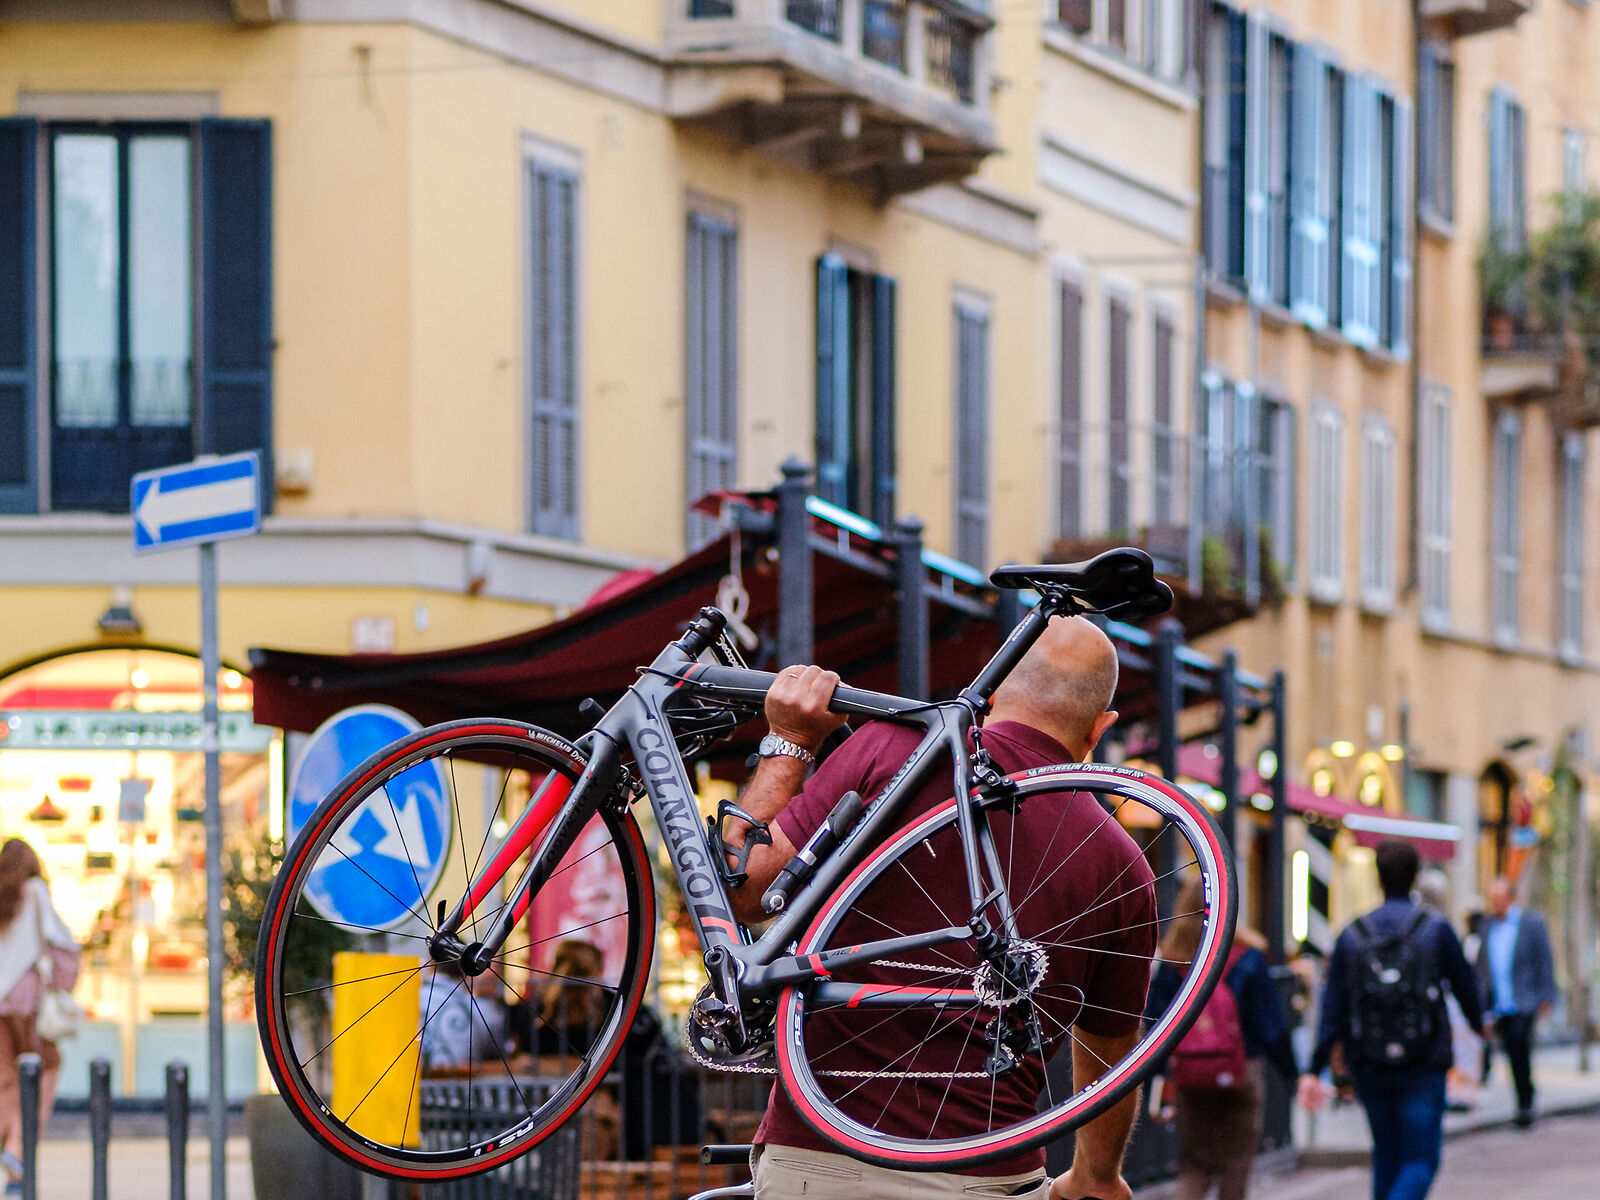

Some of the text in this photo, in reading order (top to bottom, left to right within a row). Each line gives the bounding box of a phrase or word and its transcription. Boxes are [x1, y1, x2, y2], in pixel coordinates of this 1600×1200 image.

[536, 732, 573, 753] MICHELIN
[1037, 763, 1081, 774] MICHELIN
[1082, 764, 1117, 774] Dynamic
[637, 727, 715, 899] COLNAGO
